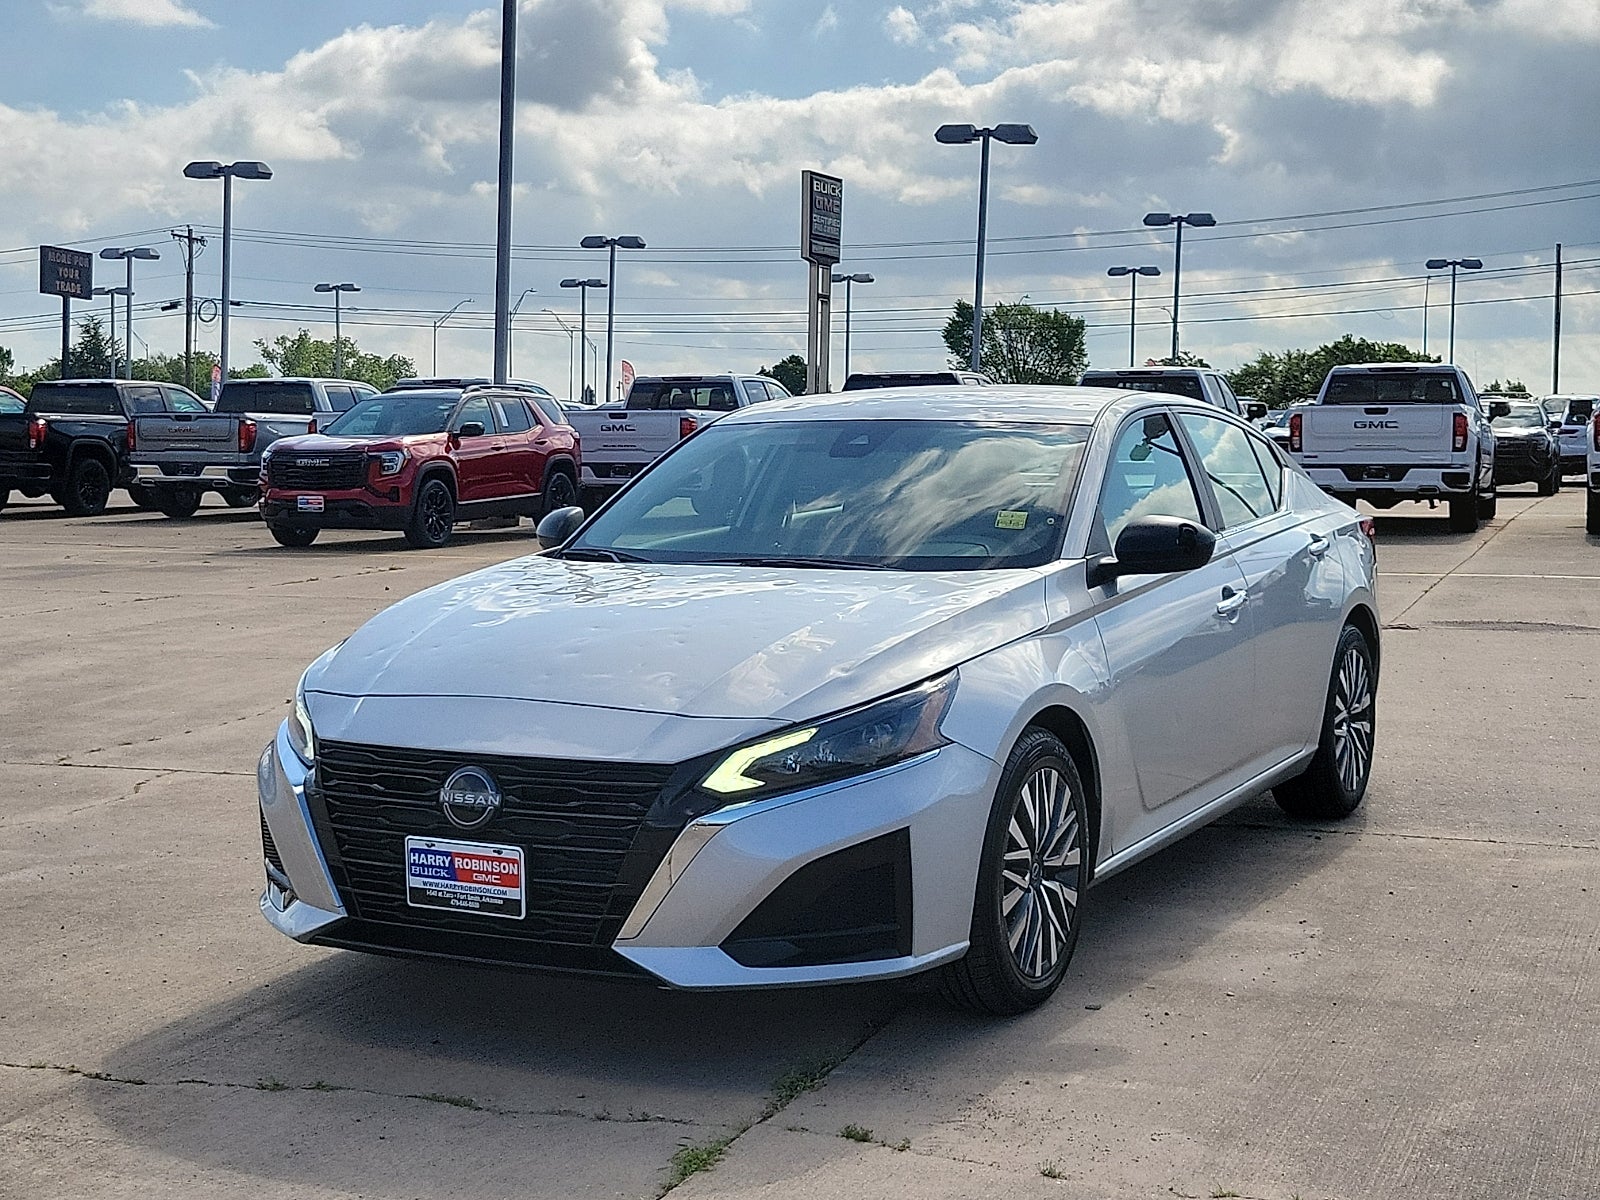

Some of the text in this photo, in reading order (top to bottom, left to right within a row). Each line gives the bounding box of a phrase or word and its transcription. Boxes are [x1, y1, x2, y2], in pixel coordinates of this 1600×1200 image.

[813, 181, 841, 197] BUICK
[59, 266, 79, 279] YOUR
[56, 280, 81, 293] TRADE
[600, 424, 637, 432] GMC
[1353, 420, 1399, 429] GMC
[439, 788, 501, 806] NISSAN
[410, 852, 518, 875] HARRY ROBINSON
[411, 866, 501, 883] BUICK GMC
